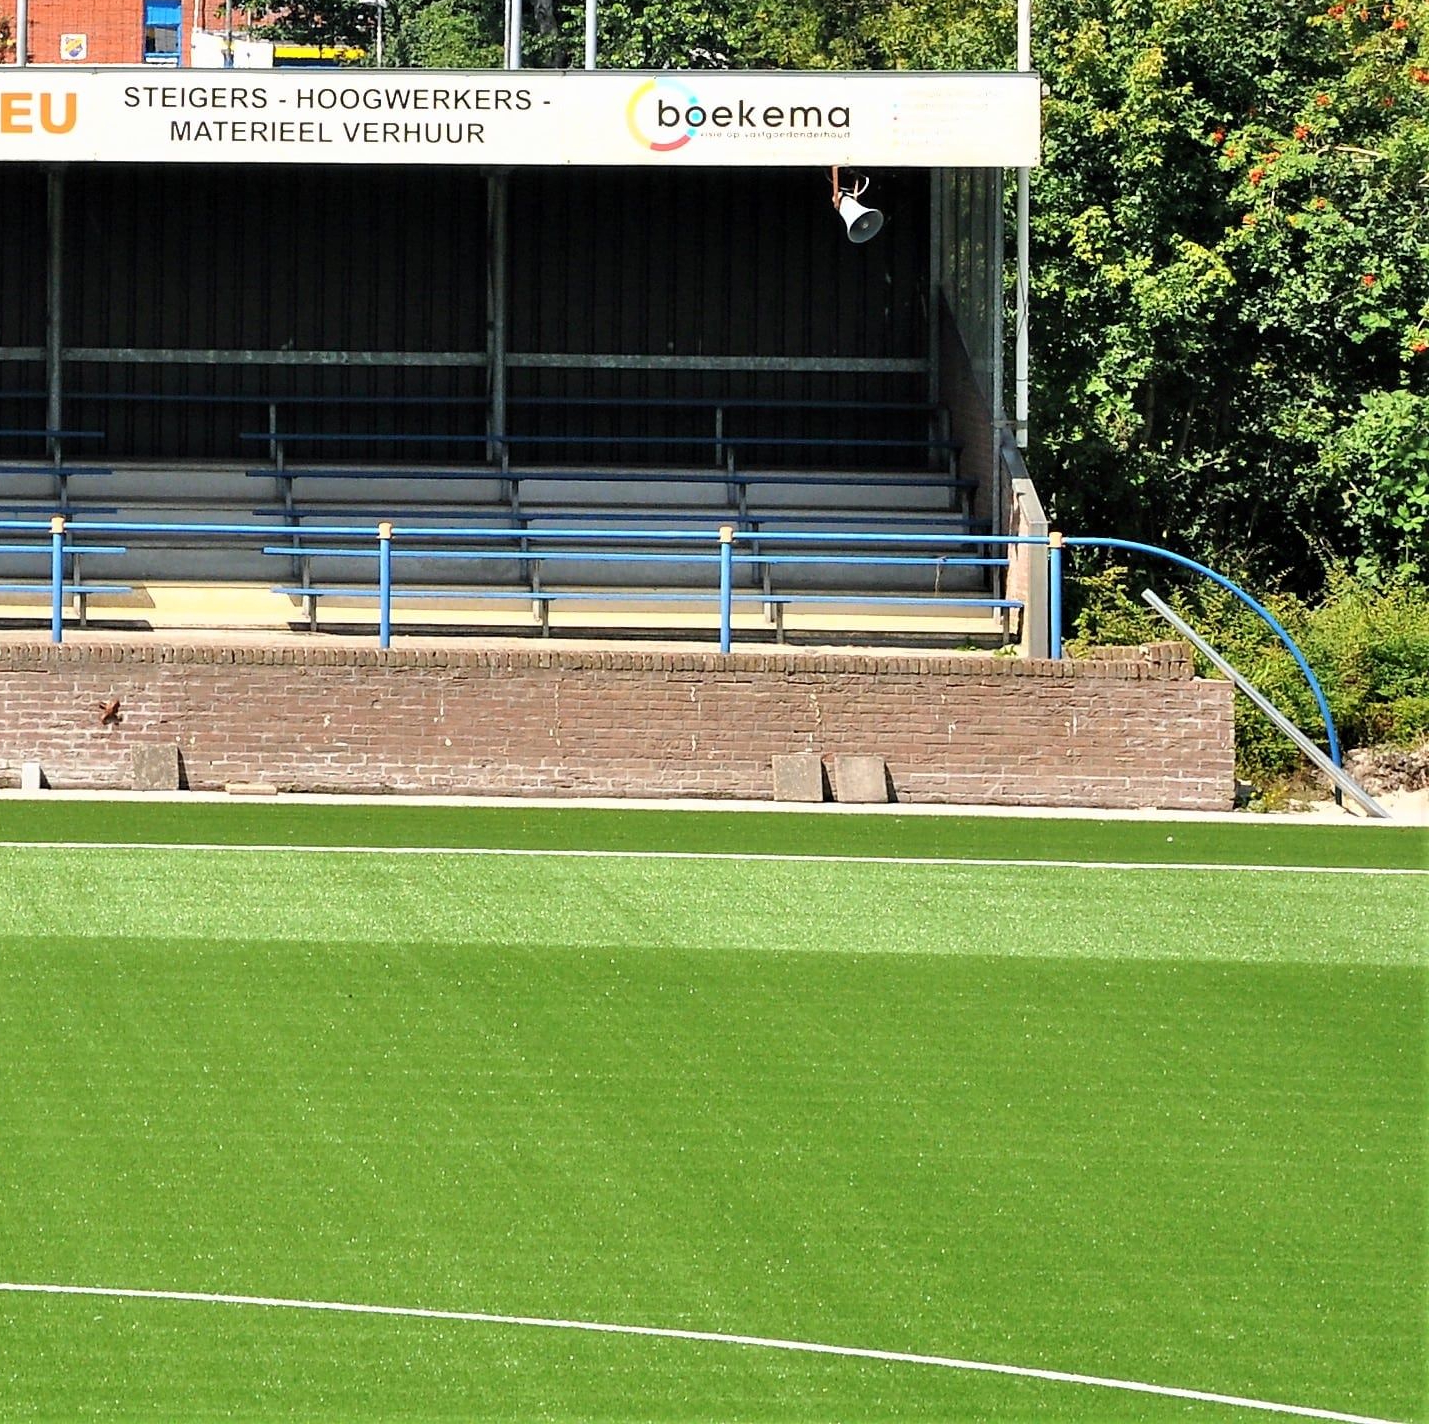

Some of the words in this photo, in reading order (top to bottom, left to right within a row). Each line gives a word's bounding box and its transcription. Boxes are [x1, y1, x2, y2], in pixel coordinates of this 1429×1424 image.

[124, 86, 268, 109] STEIGERS
[296, 88, 532, 111] HOOGWERKERS
[658, 99, 850, 128] boekema
[170, 120, 334, 143] MATERIEEL
[342, 121, 485, 144] VERHUUR
